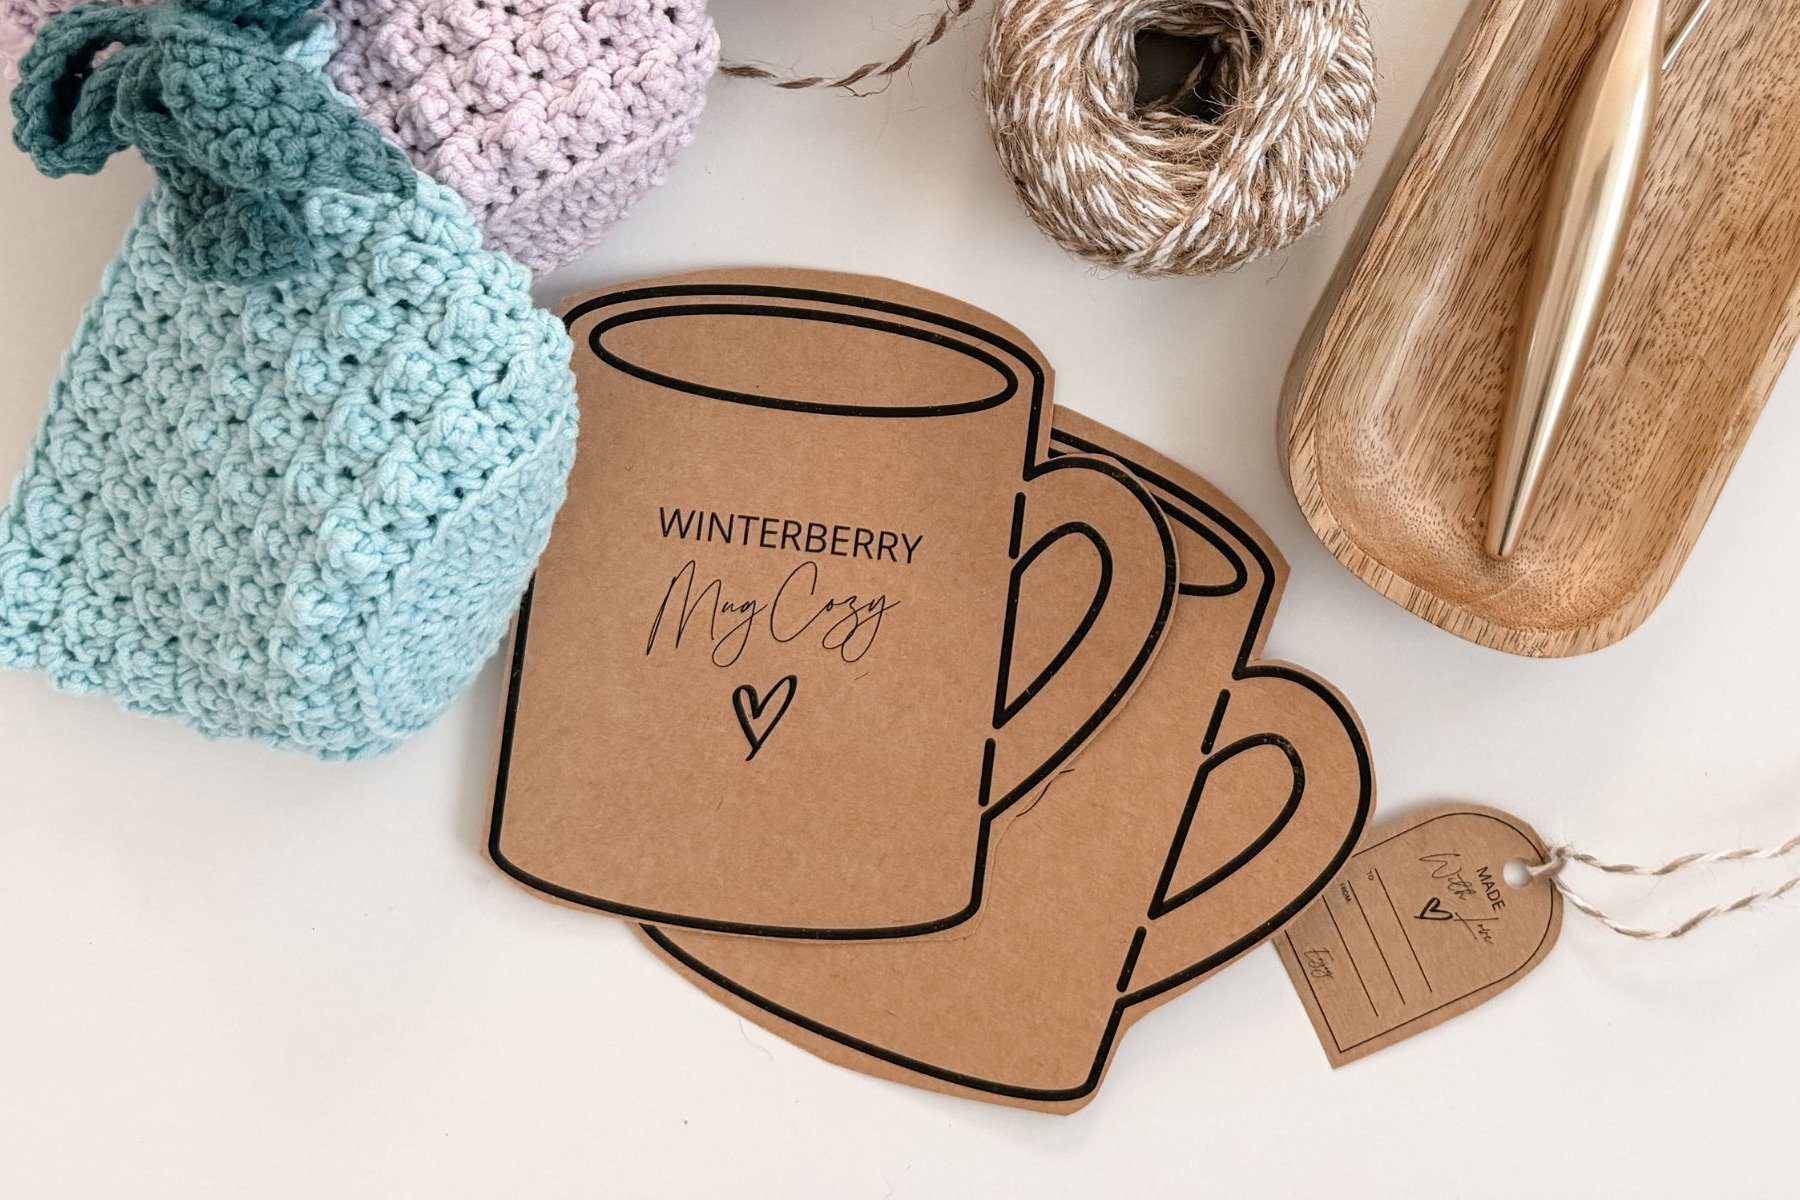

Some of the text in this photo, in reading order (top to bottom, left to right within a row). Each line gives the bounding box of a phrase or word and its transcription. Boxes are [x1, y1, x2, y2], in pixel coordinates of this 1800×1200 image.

[659, 506, 923, 564] WINTERBERRY
[646, 559, 902, 668] Mug Cozy
[1419, 852, 1477, 902] With
[1476, 866, 1506, 912] MADE
